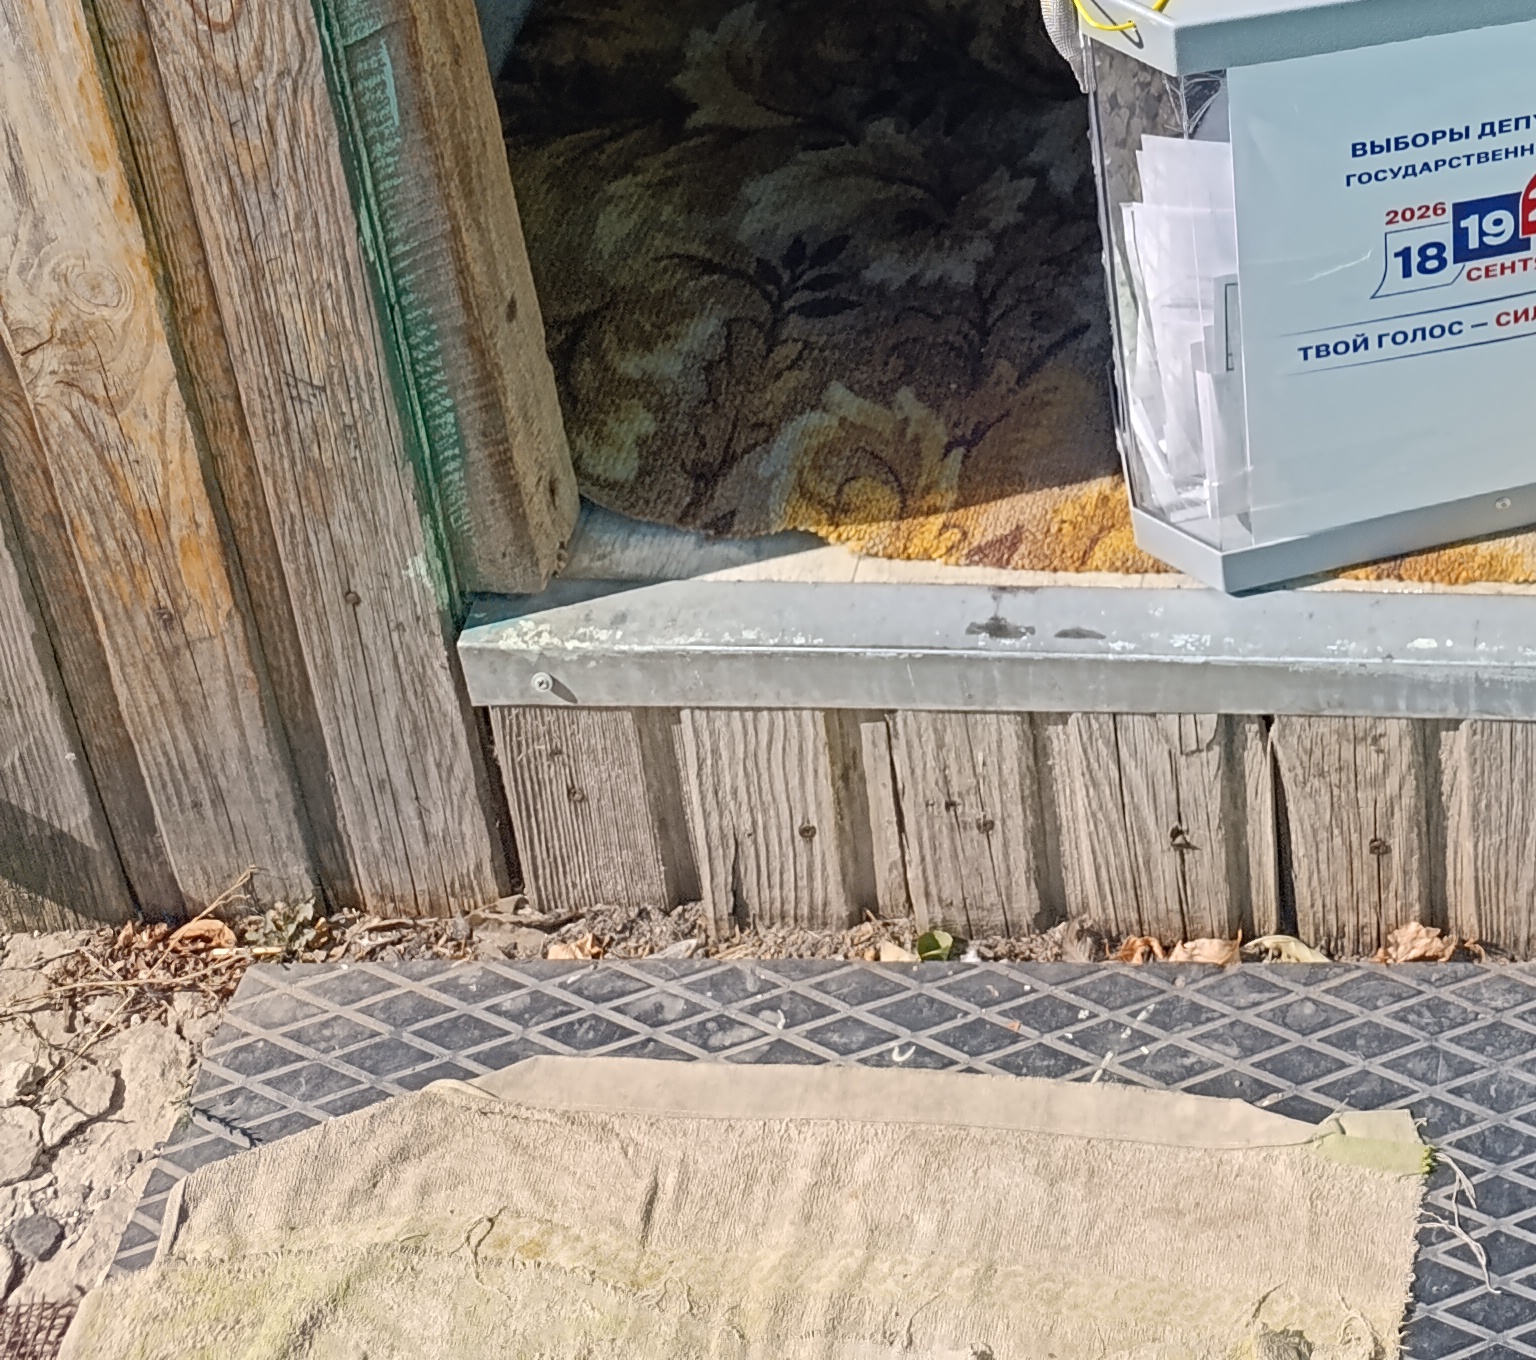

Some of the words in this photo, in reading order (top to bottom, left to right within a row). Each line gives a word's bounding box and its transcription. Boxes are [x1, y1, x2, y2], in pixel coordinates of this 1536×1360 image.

[1351, 125, 1470, 159] ВЫБОРЫ
[1385, 201, 1447, 226] 2026
[1393, 241, 1448, 279] 18
[1459, 209, 1515, 250] 19
[1297, 332, 1369, 362] ТВОЙ
[1377, 320, 1464, 350] ГОЛОС
